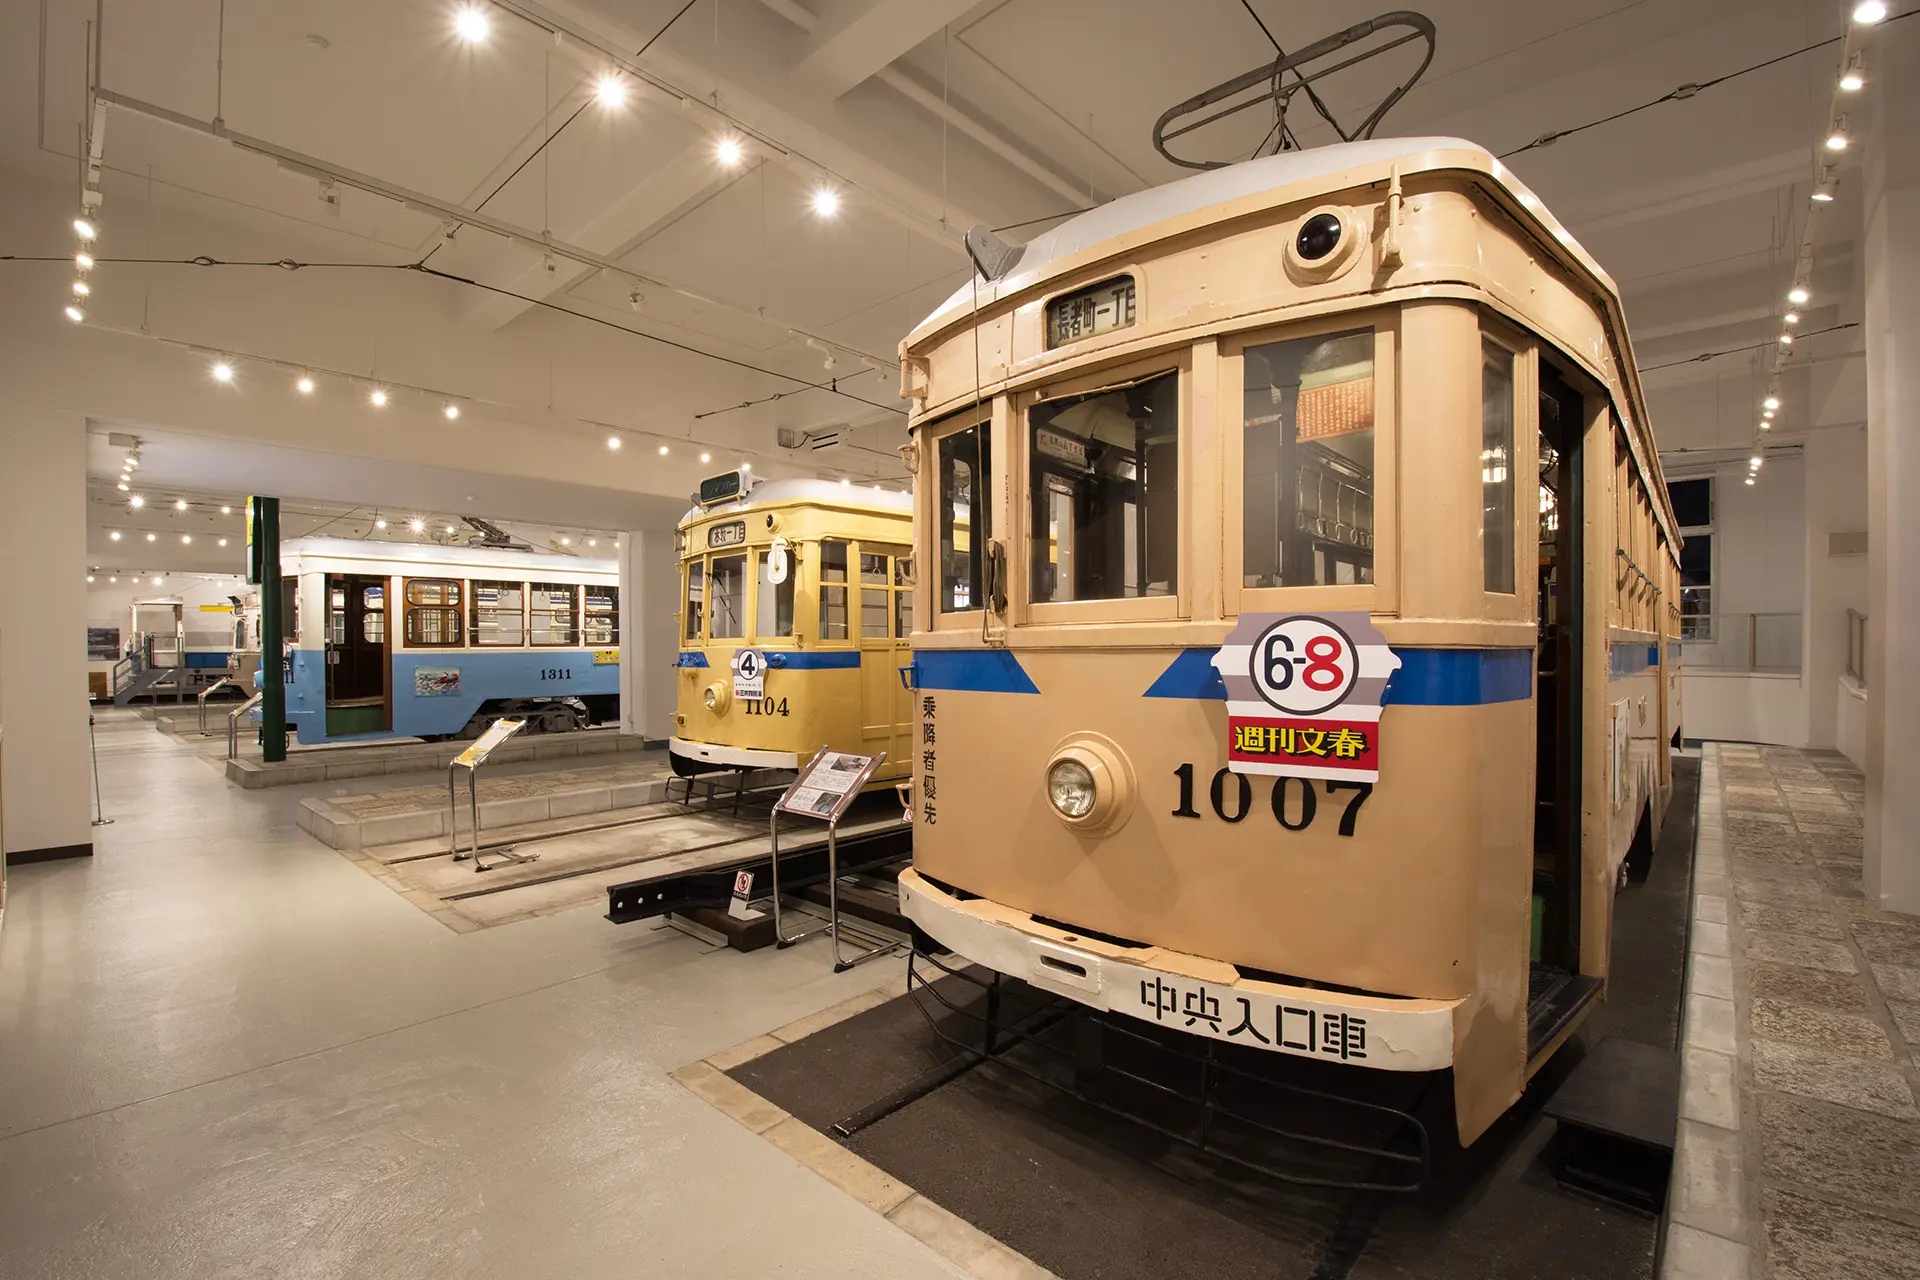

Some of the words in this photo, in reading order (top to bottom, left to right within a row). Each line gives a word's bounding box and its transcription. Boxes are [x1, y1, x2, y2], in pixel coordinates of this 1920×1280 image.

[1057, 285, 1135, 341] 長者町一丁目
[713, 522, 745, 543] 本牧一丁目
[541, 668, 572, 681] 1311
[741, 653, 756, 676] 4
[1264, 634, 1344, 692] 6-8
[745, 696, 790, 717] 1104
[923, 696, 937, 825] 乗降者優先
[1234, 725, 1368, 759] 週刊文春
[1171, 762, 1373, 837] 1007
[1140, 976, 1368, 1060] 中央入口車
